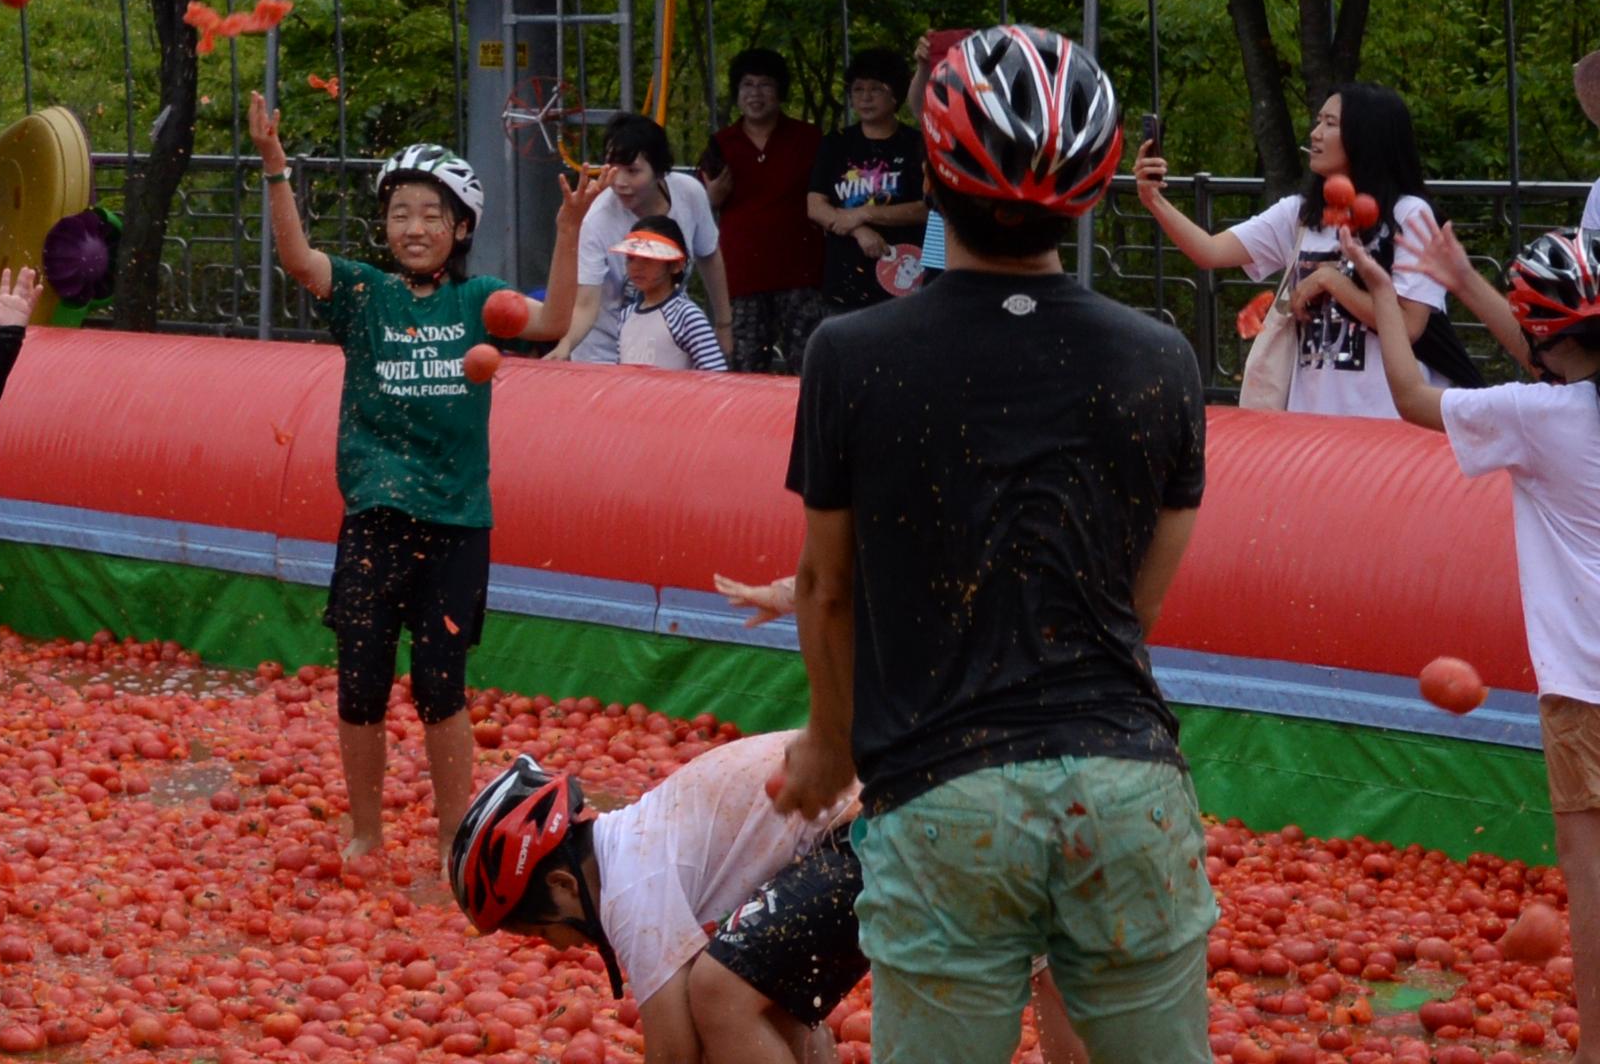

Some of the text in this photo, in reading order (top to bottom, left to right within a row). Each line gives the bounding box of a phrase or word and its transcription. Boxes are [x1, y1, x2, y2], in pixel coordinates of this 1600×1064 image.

[834, 171, 902, 201] WIN IT
[375, 357, 466, 380] HOTEL URME
[421, 384, 468, 396] FLORIDA
